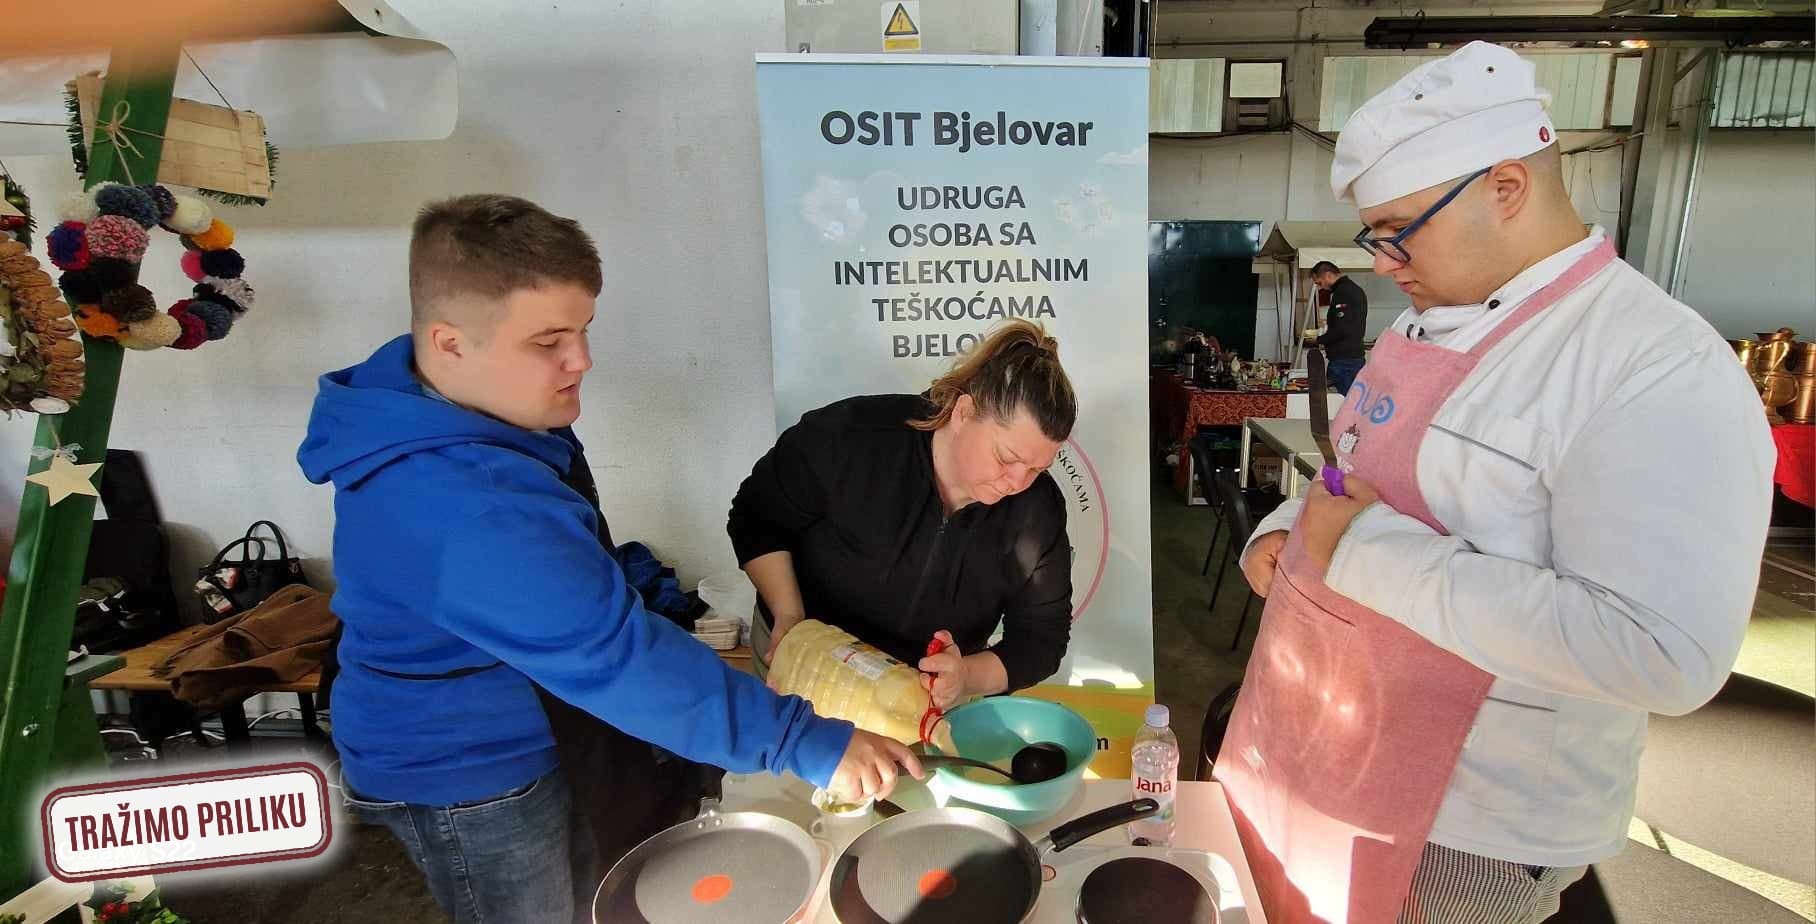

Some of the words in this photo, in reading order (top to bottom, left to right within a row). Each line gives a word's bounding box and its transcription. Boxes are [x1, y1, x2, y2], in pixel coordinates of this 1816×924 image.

[820, 110, 922, 146] OSIT
[933, 110, 1094, 154] Bjelovar
[897, 185, 1026, 210] UDRUGA
[888, 223, 993, 248] OSOBA
[1000, 222, 1036, 246] SA
[834, 258, 1088, 286] INTELEKTUALNIM
[871, 291, 1056, 322] TEŠKOĆAMA
[892, 333, 986, 358] BJELO
[1057, 449, 1091, 513] ŠKOĆAMA
[1136, 777, 1171, 793] Jana
